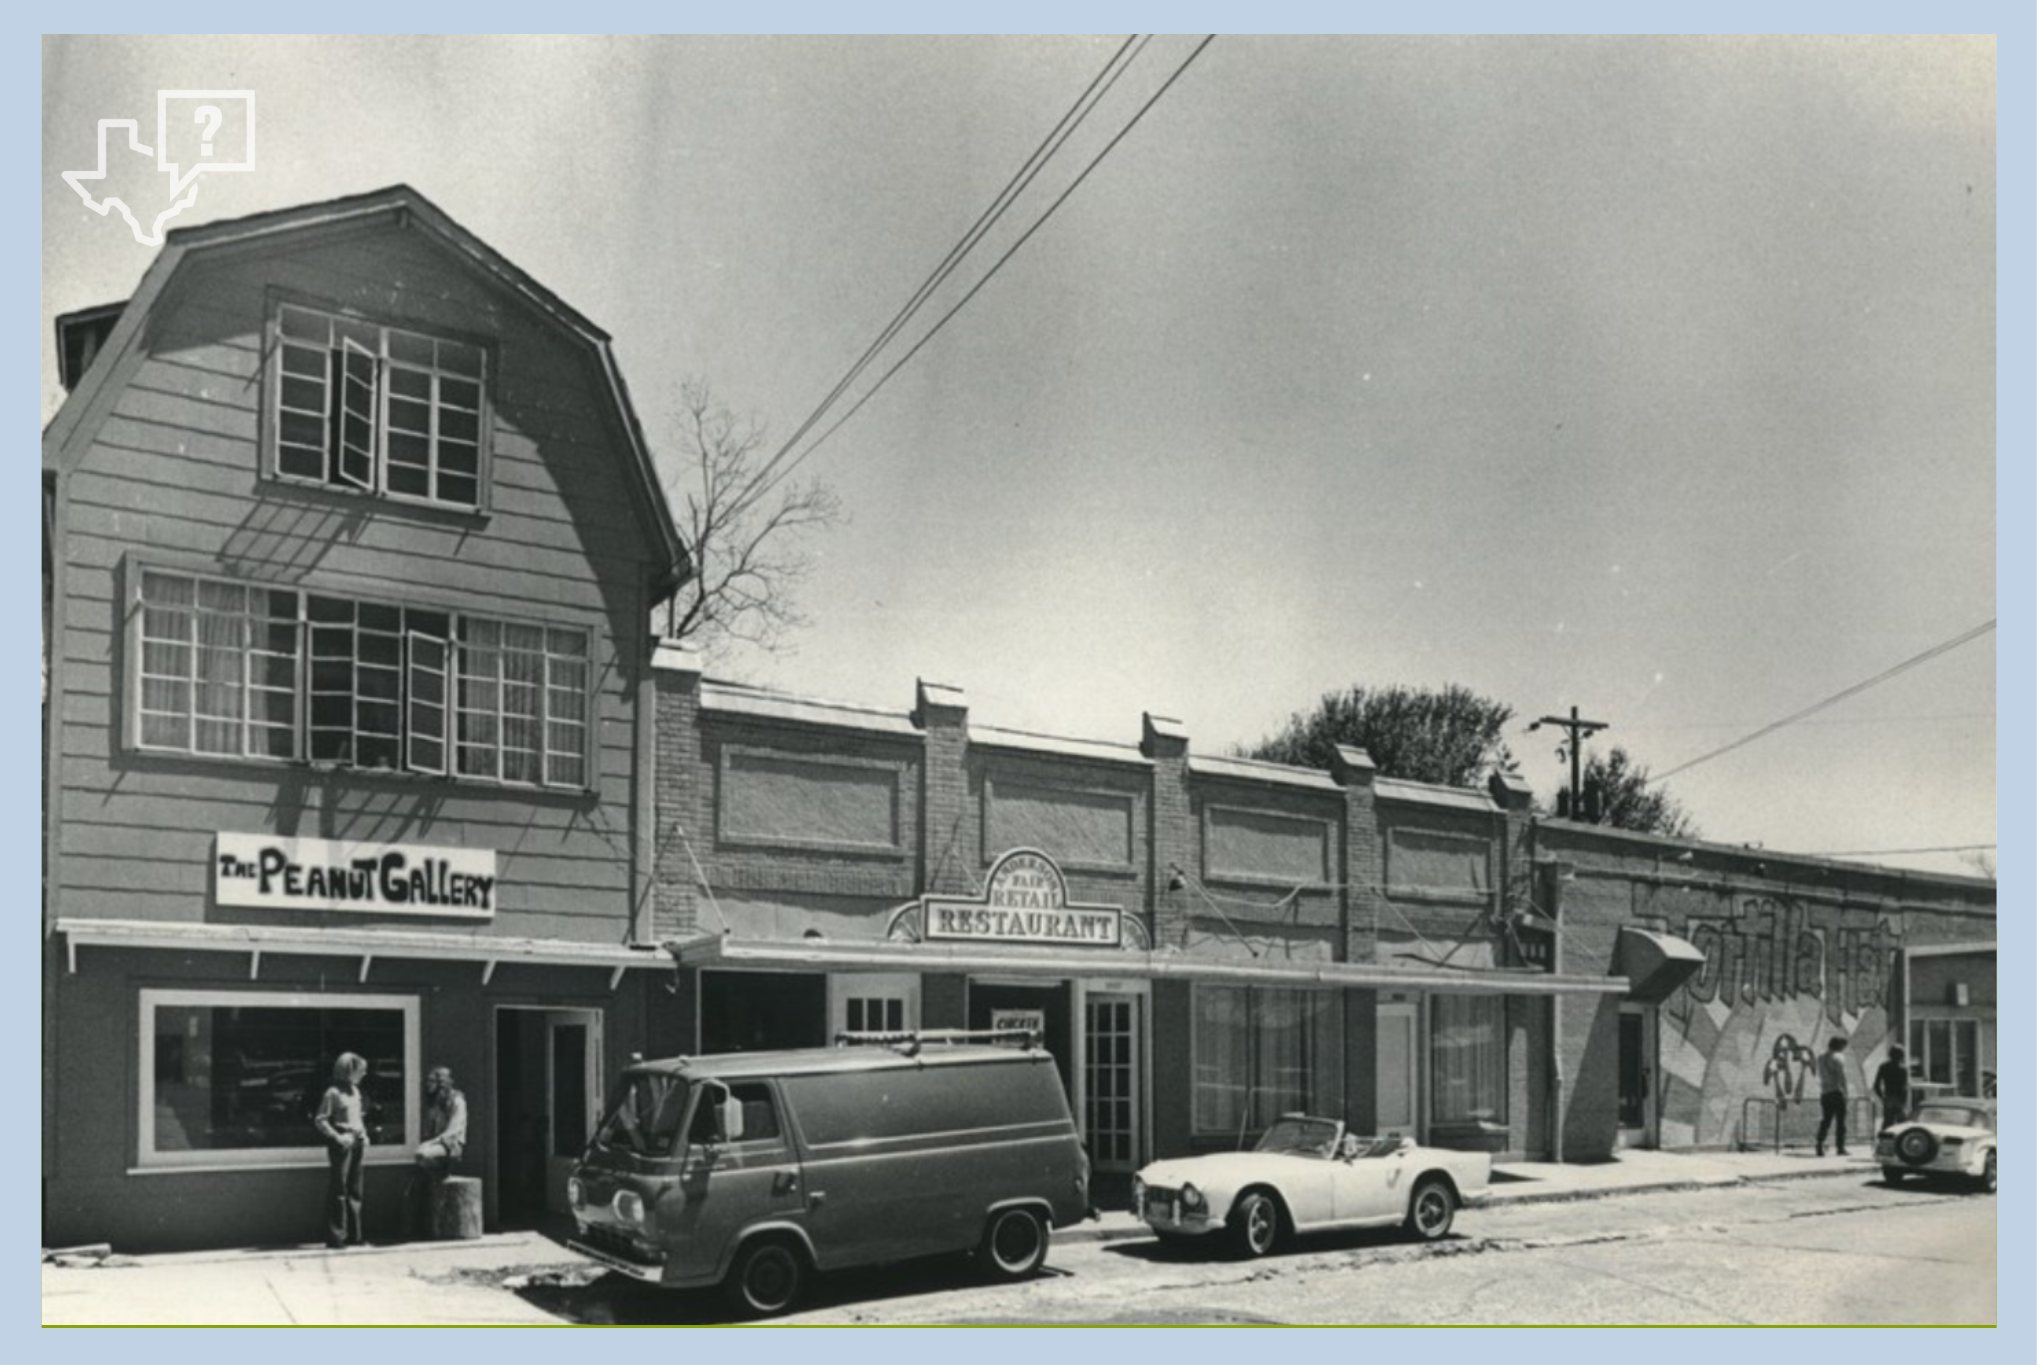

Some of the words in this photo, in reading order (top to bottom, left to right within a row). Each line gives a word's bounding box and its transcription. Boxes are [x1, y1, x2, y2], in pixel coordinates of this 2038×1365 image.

[257, 845, 378, 902] PEANUT
[379, 852, 494, 910] GALLERY
[993, 890, 1063, 910] RETAIL
[936, 907, 1112, 940] RESTAURANT
